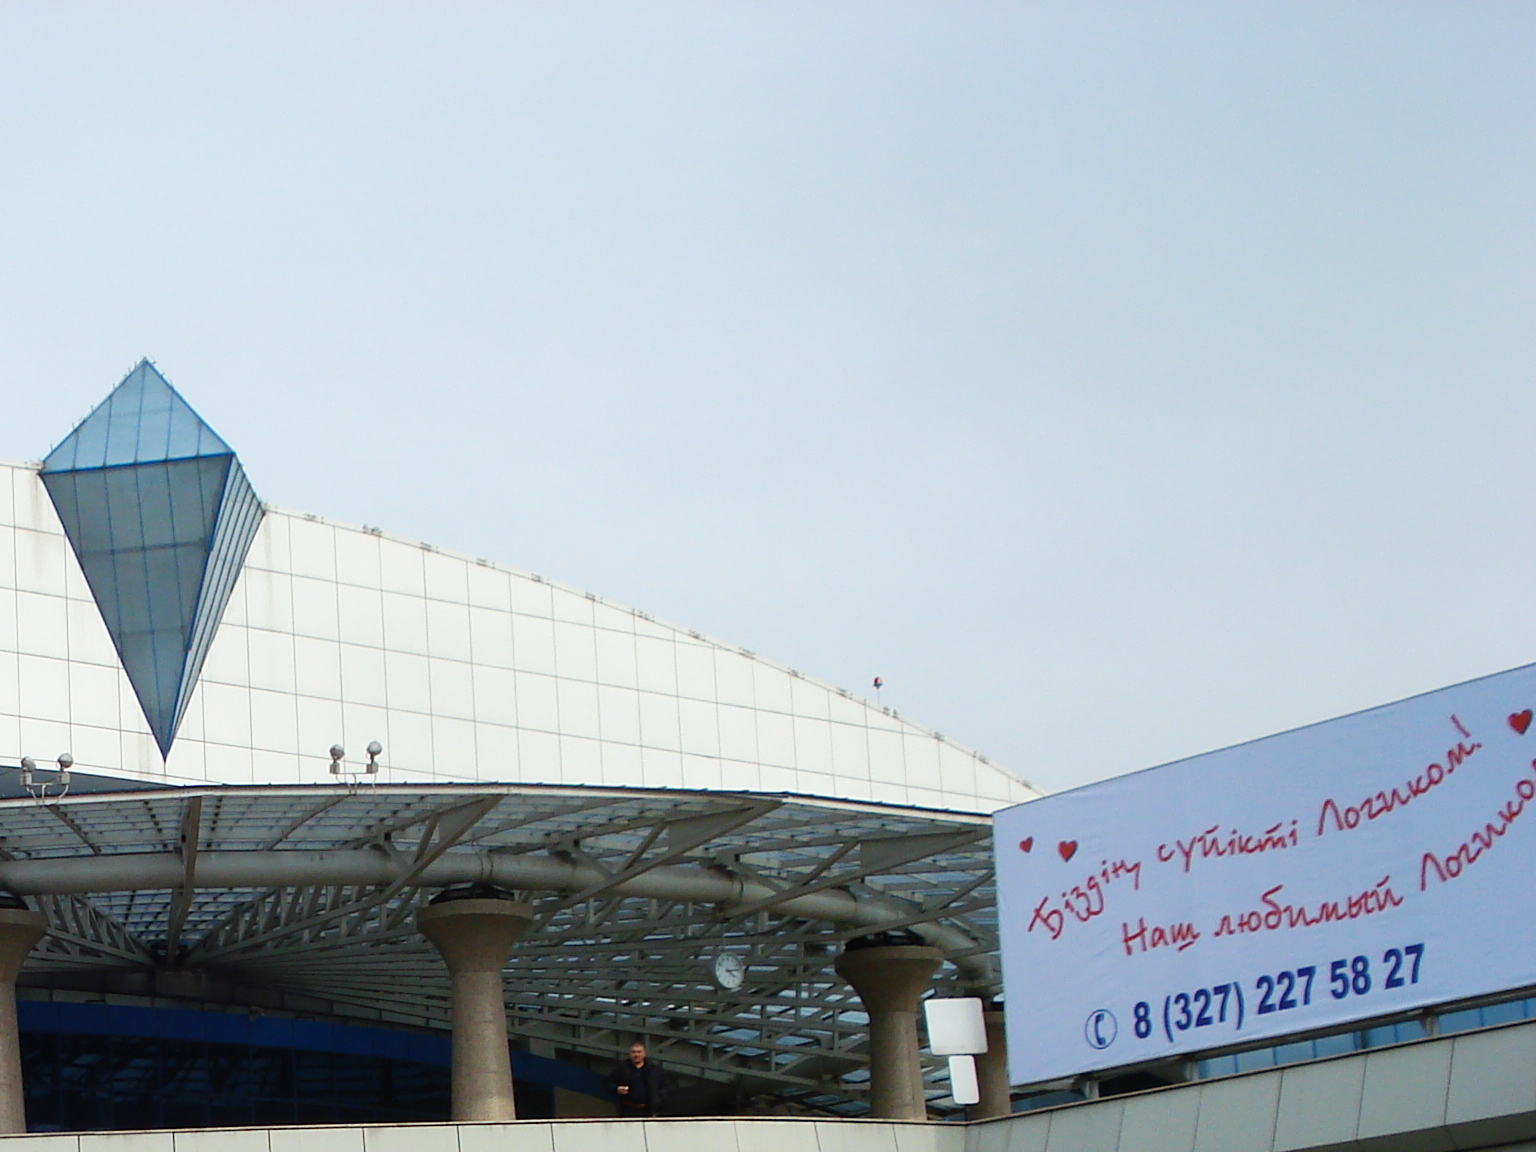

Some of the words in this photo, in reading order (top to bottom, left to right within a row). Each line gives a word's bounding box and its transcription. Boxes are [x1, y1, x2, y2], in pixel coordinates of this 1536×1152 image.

[1121, 915, 1202, 956] Наш
[1213, 874, 1405, 938] любимый
[1419, 757, 1536, 892] Логико
[1133, 1000, 1153, 1040] 8
[1163, 980, 1246, 1044] (327)
[1255, 964, 1317, 1016] 227
[1329, 953, 1373, 1000] 58
[1382, 942, 1427, 990] 27
